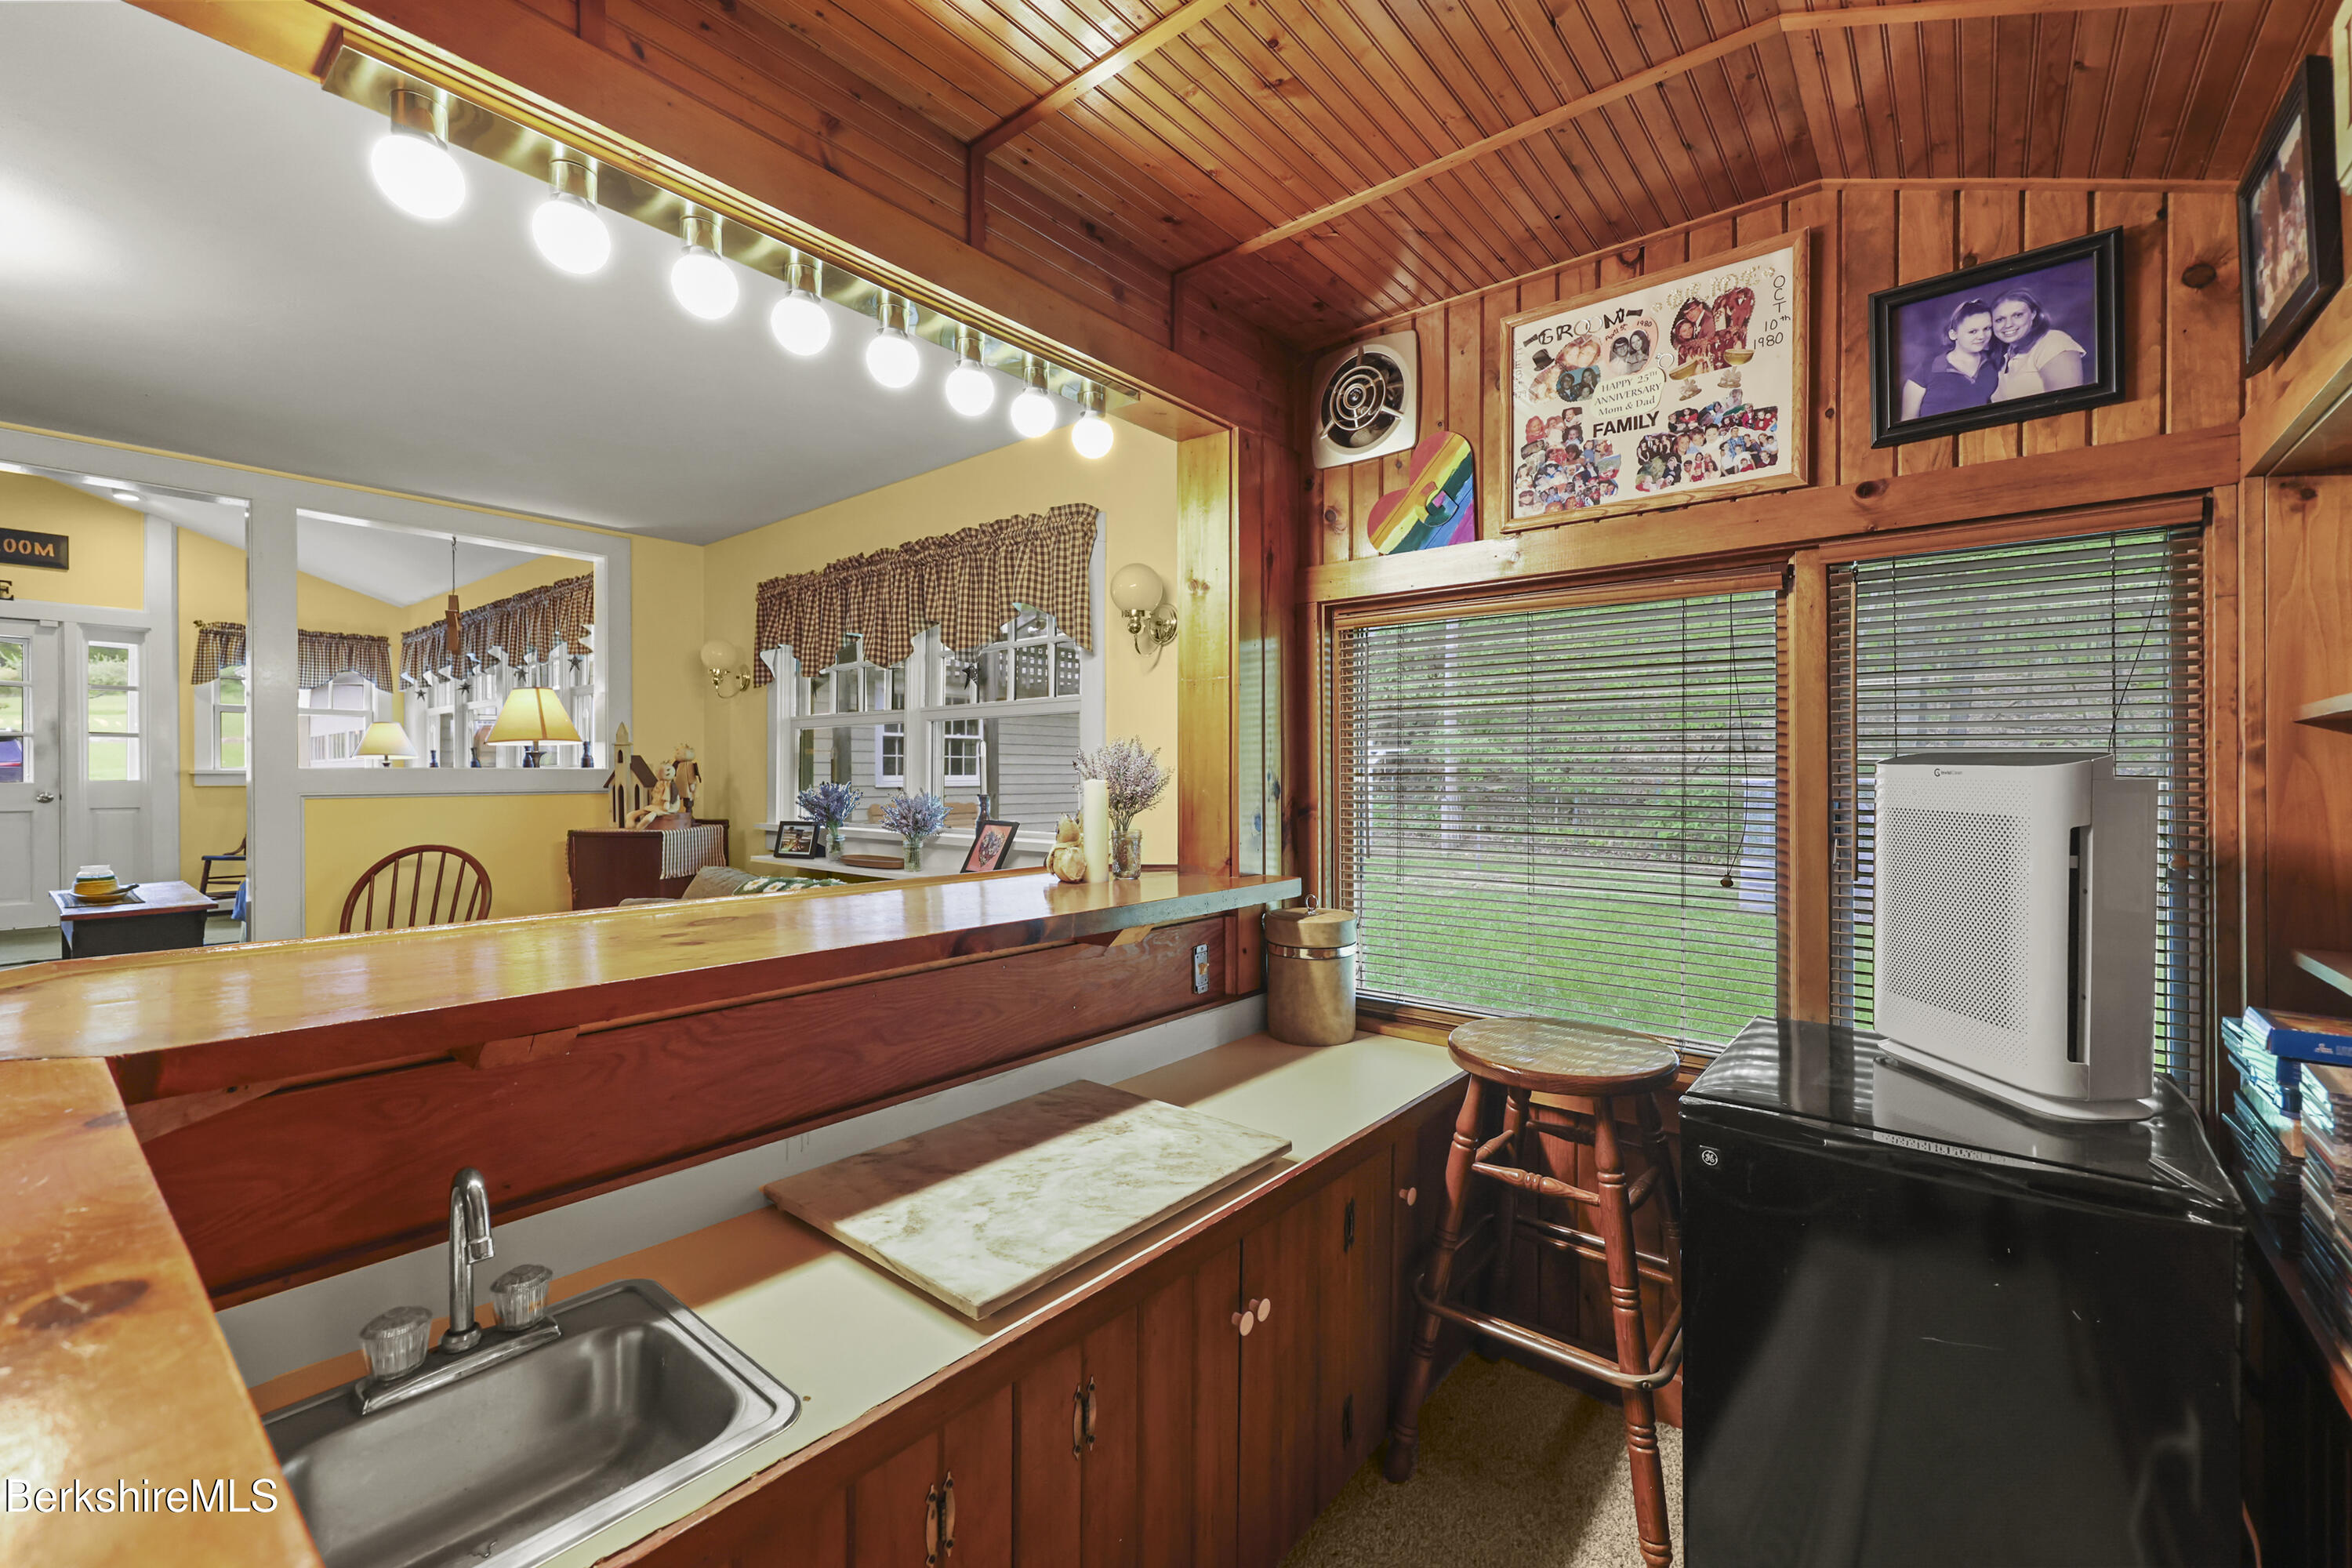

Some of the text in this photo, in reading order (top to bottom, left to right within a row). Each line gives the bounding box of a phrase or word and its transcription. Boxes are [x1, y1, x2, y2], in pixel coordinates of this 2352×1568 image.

[1773, 275, 1787, 313] OCT
[1764, 315, 1791, 332] 10th
[1753, 332, 1784, 350] 1980
[1594, 383, 1661, 405] ANNIVERSARY
[1601, 377, 1632, 392] HAPPY
[1599, 395, 1655, 416] Mom & Dad
[1592, 410, 1660, 438] FAMILY
[1, 539, 55, 557] OOM
